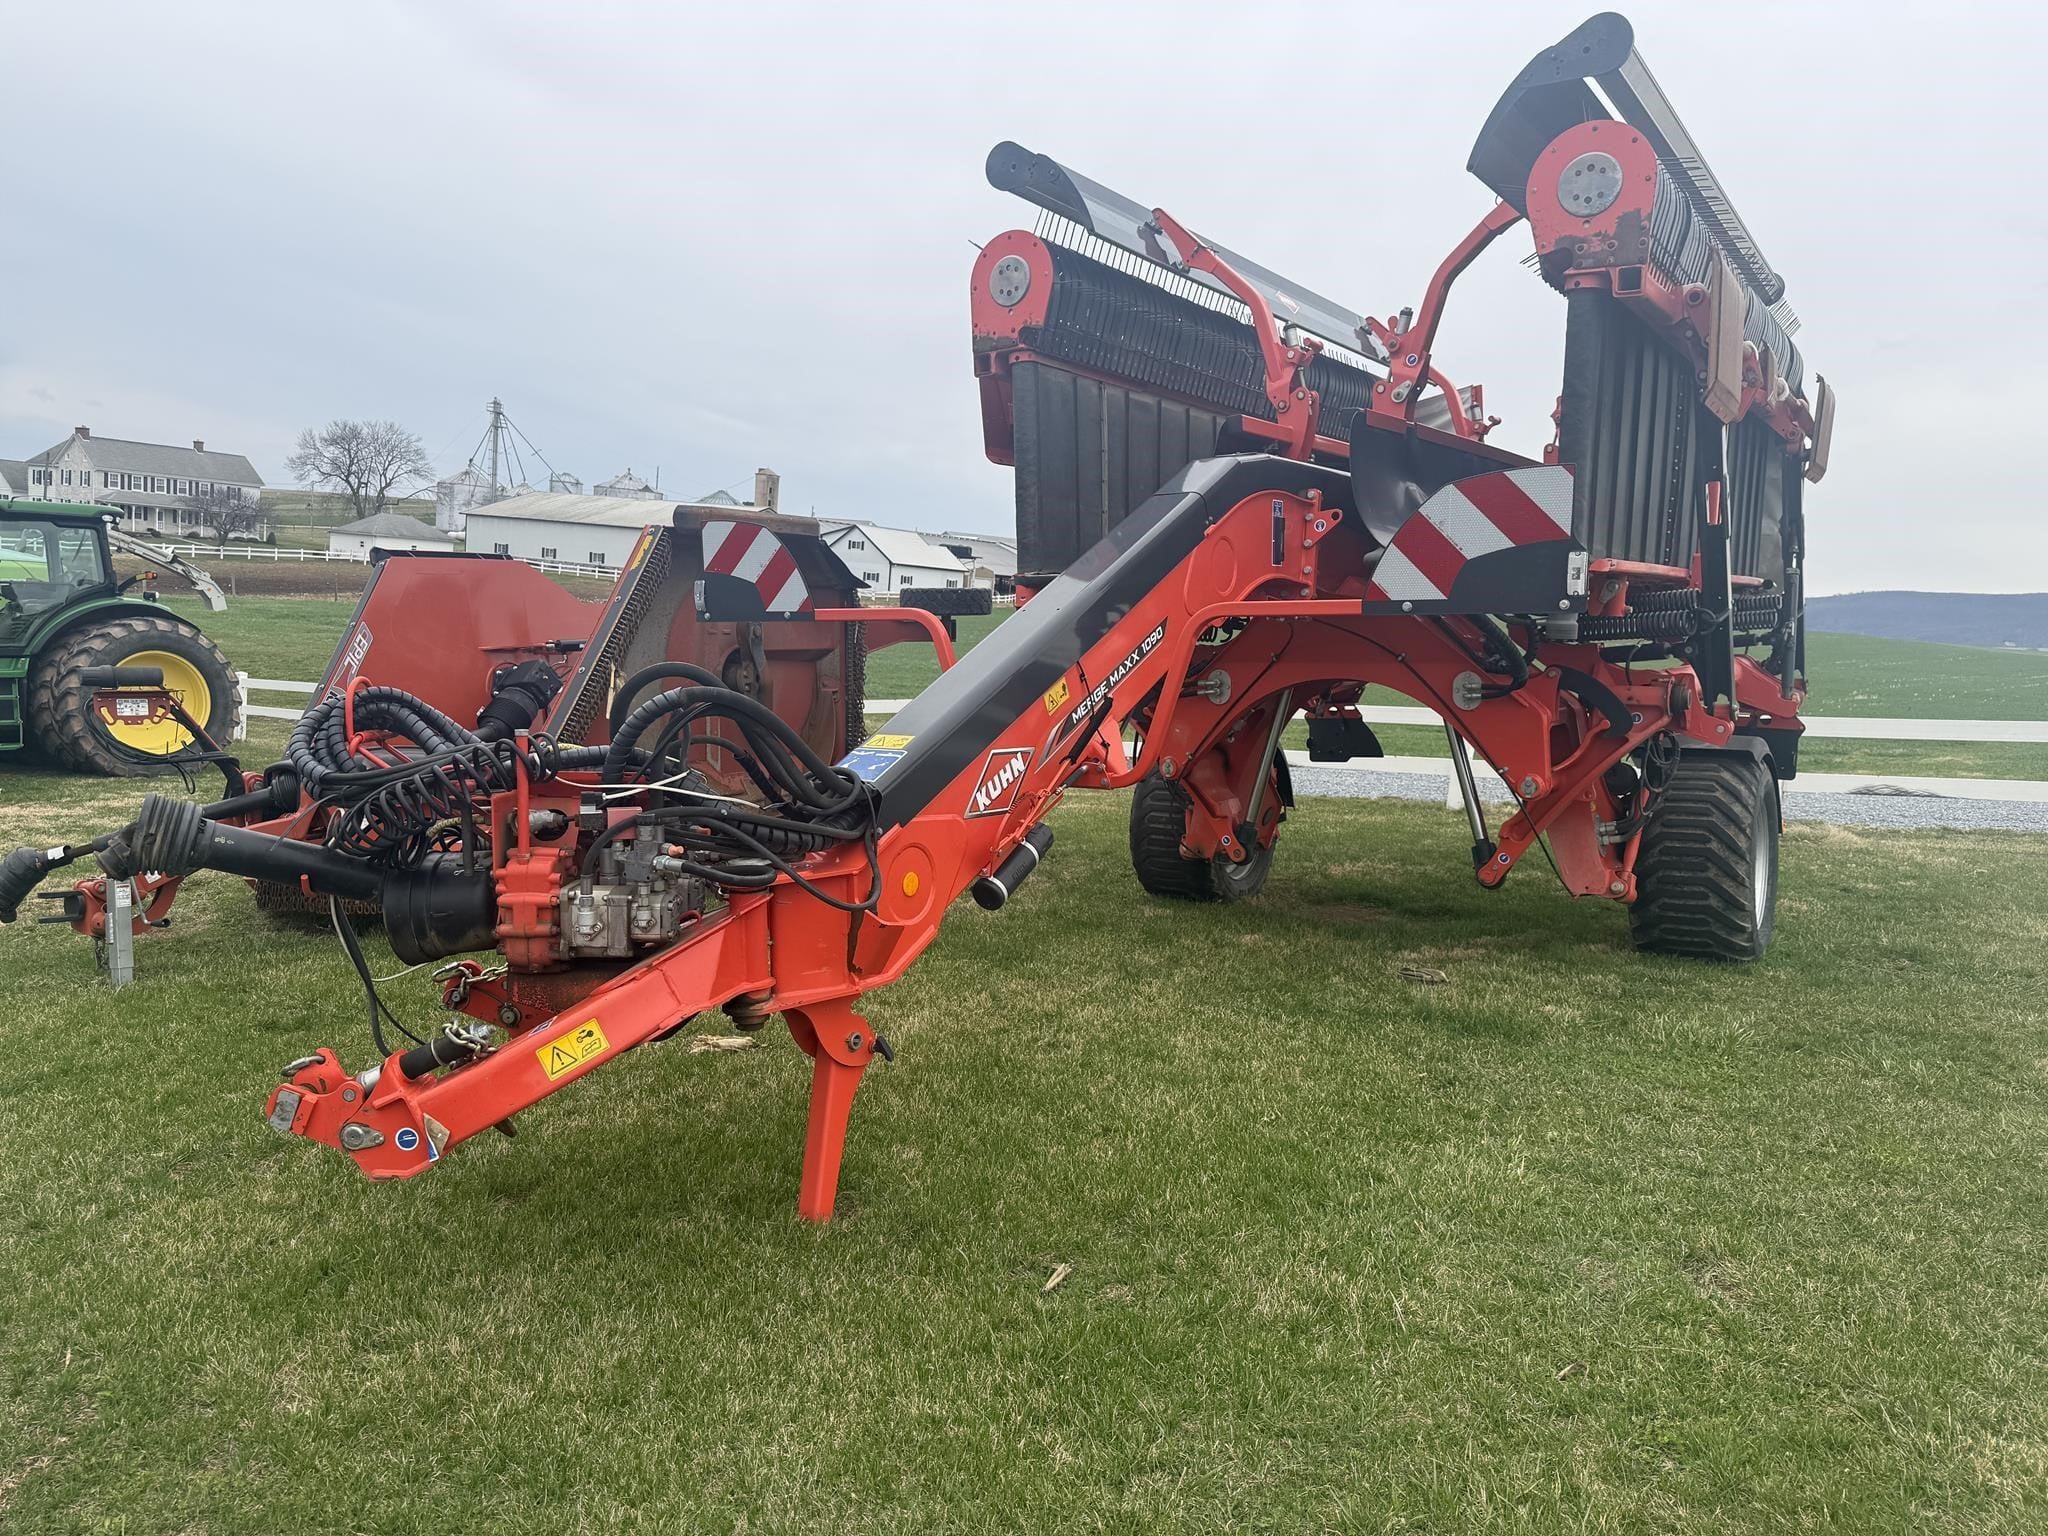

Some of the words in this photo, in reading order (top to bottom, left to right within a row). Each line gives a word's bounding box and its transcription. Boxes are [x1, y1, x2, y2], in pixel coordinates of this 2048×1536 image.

[1072, 681, 1109, 724] MERGE
[1109, 649, 1140, 686] MAXX
[1141, 626, 1163, 653] 1090
[976, 752, 1025, 811] KUHN
